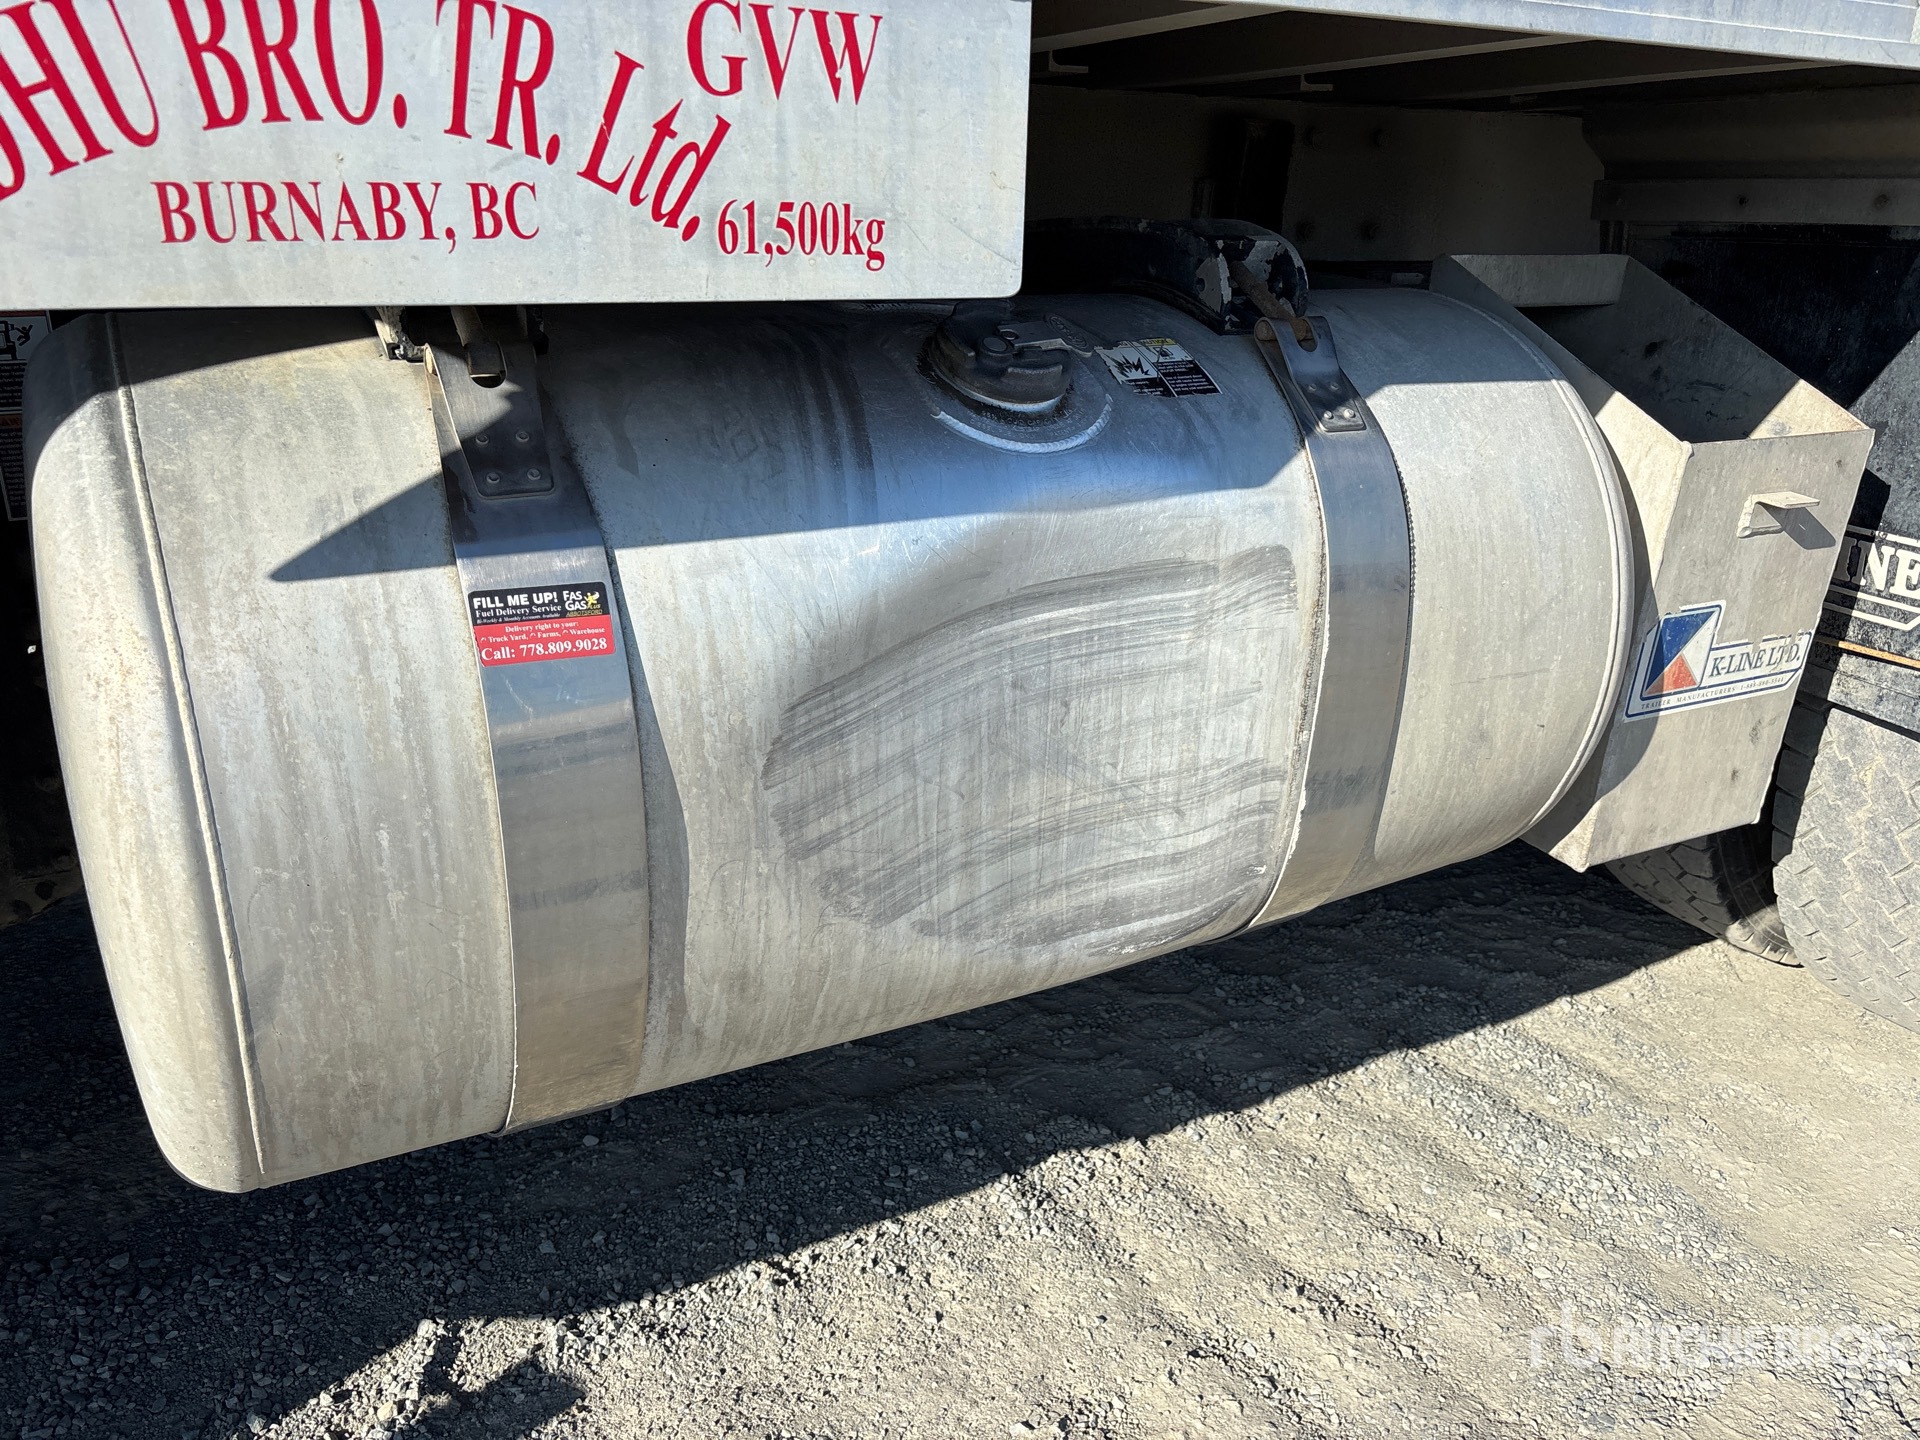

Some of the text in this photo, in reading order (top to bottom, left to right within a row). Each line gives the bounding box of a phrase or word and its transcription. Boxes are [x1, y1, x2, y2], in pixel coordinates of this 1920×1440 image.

[687, 0, 883, 105] GVW
[168, 0, 408, 132] BRO.
[436, 0, 560, 165] TR.
[577, 50, 731, 242] Ltd.
[150, 180, 539, 254] BURNABY, BC
[718, 199, 886, 271] 61,500kg
[473, 592, 558, 609] FILL ME UP!
[563, 590, 583, 601] FAS
[565, 600, 587, 611] GAS
[476, 604, 562, 618] Fuel Delivery Service
[488, 635, 508, 643] Truck
[569, 627, 605, 635] Warehouse
[481, 637, 608, 661] Call: 778.809.9028
[1708, 643, 1800, 677] K-LINE LTD.
[1641, 699, 1671, 710] TRAILER
[1676, 686, 1736, 703] MANUFACTURERS
